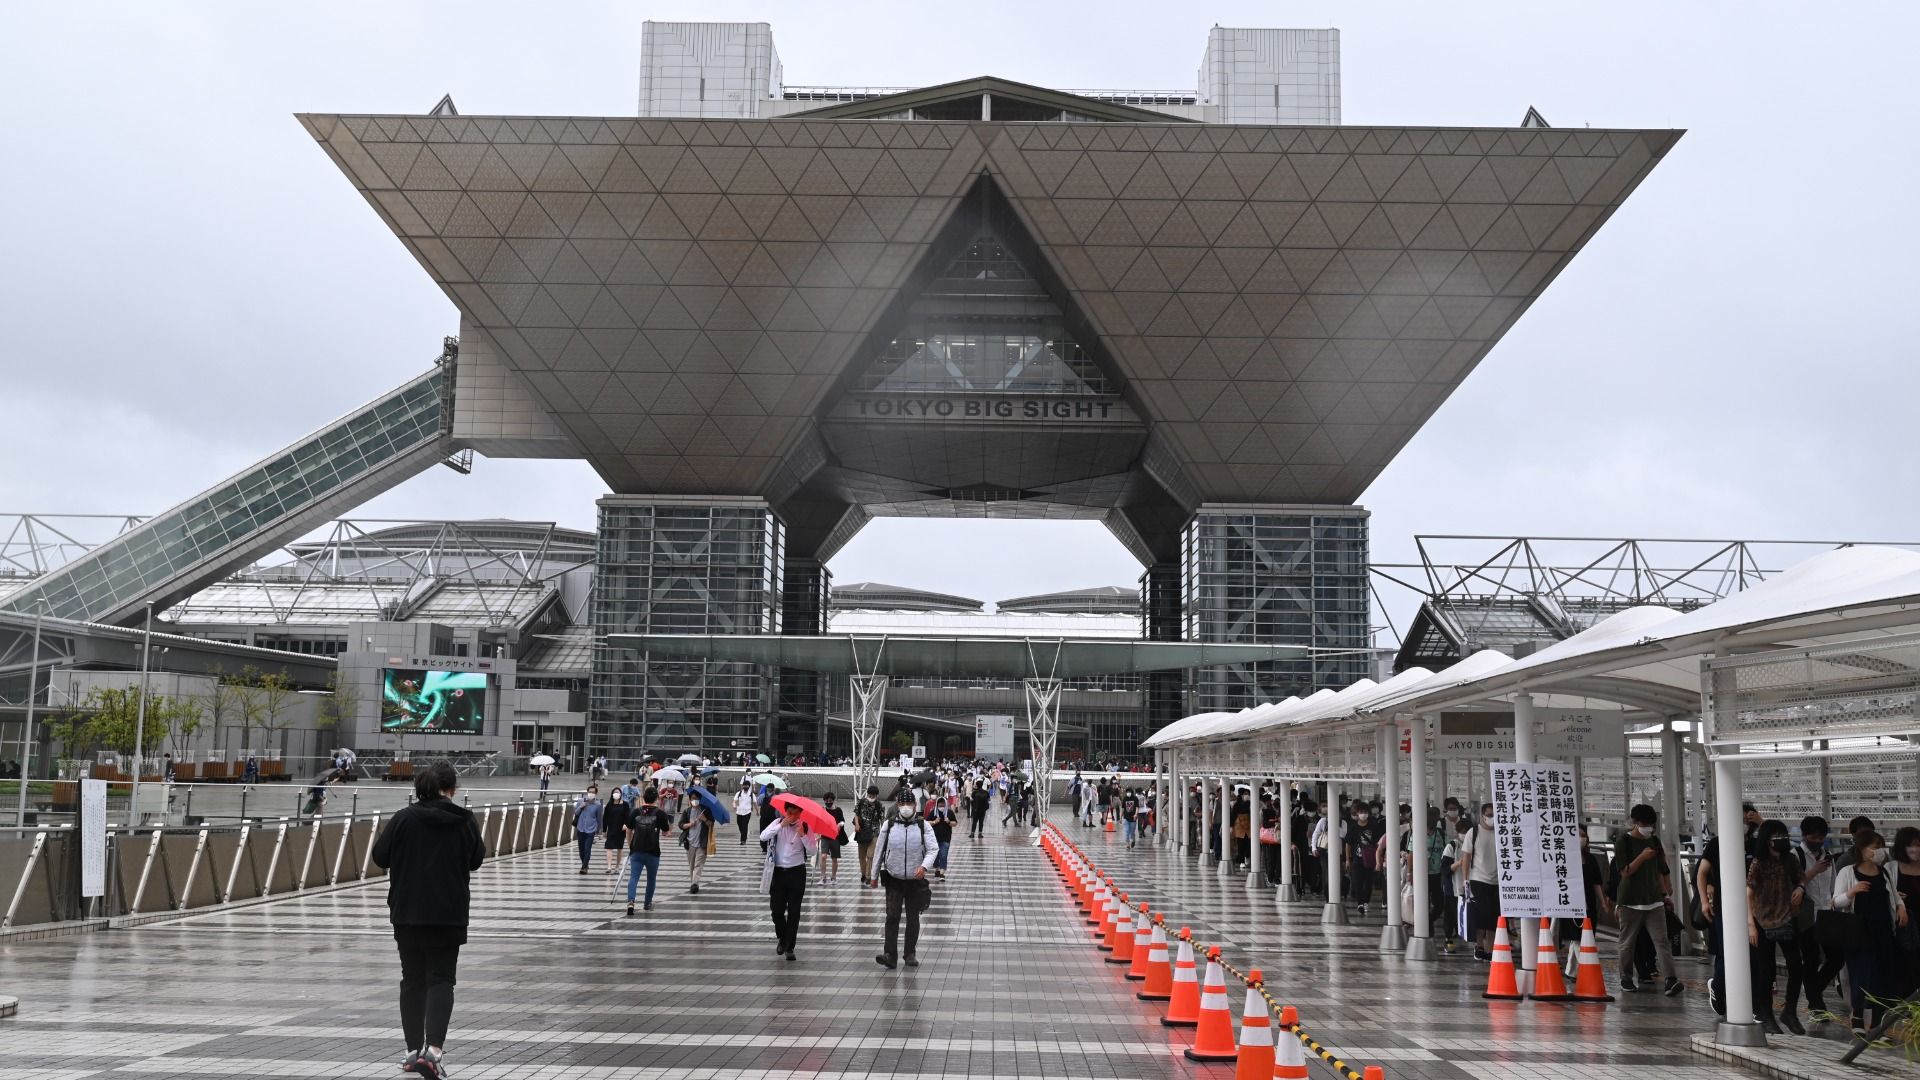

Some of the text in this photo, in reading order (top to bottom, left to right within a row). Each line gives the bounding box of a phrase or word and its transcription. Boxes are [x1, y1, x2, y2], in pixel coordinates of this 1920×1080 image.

[857, 399, 1114, 418] TOKYO BIG SIGHT
[1448, 741, 1515, 749] KYO BIG SIG
[1494, 768, 1513, 882] 当日販売はありません
[1507, 769, 1525, 870] チケットが必要です
[1520, 769, 1534, 814] 入場には
[1536, 769, 1554, 864] ご遠慮ください
[1562, 771, 1577, 837] この場所で
[1548, 770, 1570, 906] 指定時間の案内待ちは
